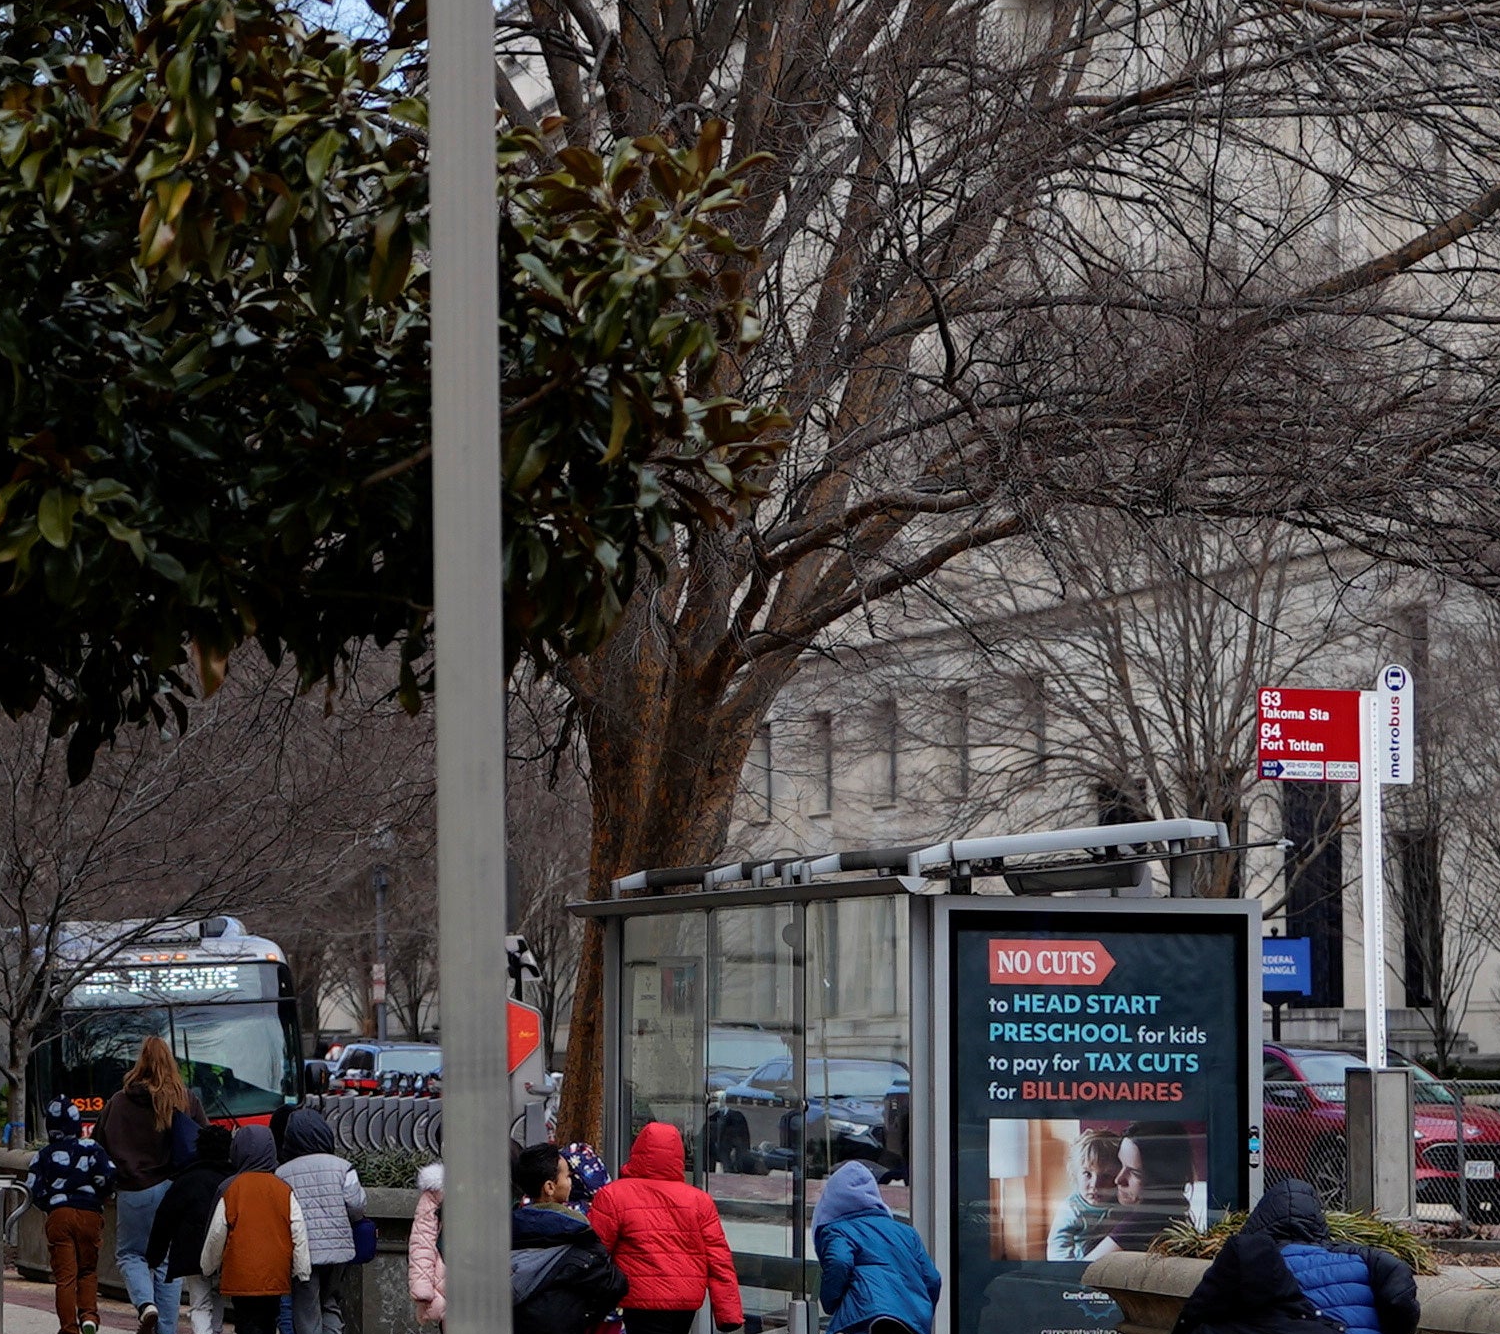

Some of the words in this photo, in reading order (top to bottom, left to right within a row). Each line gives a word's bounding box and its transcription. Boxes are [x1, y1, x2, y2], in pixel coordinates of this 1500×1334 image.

[1260, 690, 1282, 707] 63
[1261, 706, 1305, 720] Takoma
[1309, 708, 1330, 721] Sta
[1260, 722, 1282, 738] 64
[1389, 695, 1401, 779] metrobus
[1260, 738, 1284, 751] Fort
[1287, 739, 1324, 752] Totten
[997, 950, 1032, 974] NO
[1036, 950, 1096, 975] CUTS
[1262, 955, 1295, 965] EDERAL
[988, 997, 1009, 1013] to
[1013, 994, 1082, 1013] HEAD
[1086, 995, 1161, 1014] START
[989, 1022, 1132, 1043] PRESCHOOL
[1137, 1025, 1165, 1044] for
[1169, 1026, 1207, 1044] kids
[988, 1054, 1009, 1071] to
[1012, 1056, 1048, 1076] pay
[1052, 1053, 1080, 1072] for
[1084, 1052, 1132, 1072] TAX
[1137, 1053, 1199, 1073] CUTS
[988, 1081, 1017, 1100] for
[1022, 1081, 1183, 1101] BILLIONAIRES
[71, 1097, 104, 1112] S13
